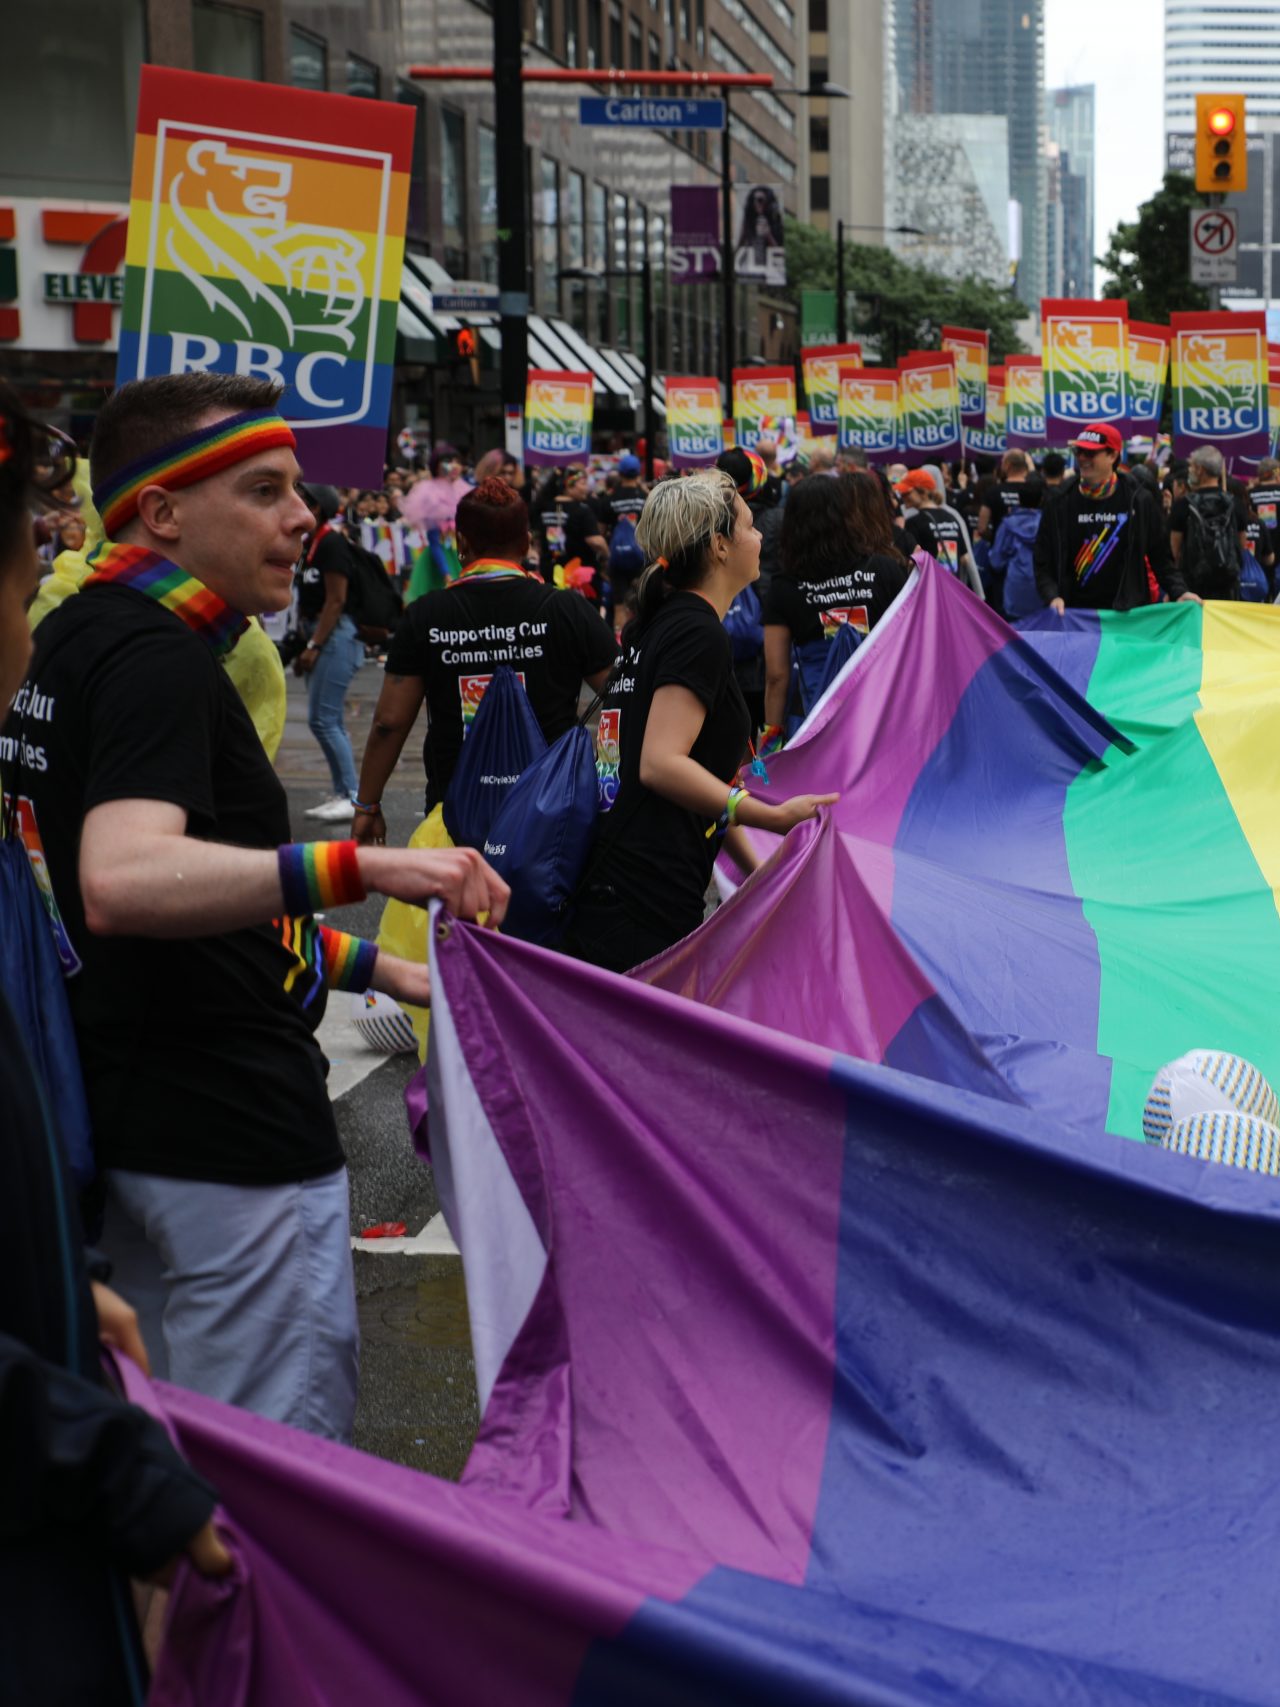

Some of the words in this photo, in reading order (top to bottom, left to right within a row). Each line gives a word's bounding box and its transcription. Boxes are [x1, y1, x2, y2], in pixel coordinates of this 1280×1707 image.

[605, 101, 682, 121] Carlton
[45, 274, 124, 300] ELEVE
[169, 331, 348, 409] RBC
[960, 392, 980, 410] BC
[1059, 391, 1118, 414] RBC
[1017, 415, 1045, 432] RB
[1190, 406, 1254, 430] RBC
[535, 432, 580, 450] RBC
[849, 429, 891, 446] RBC
[912, 422, 954, 445] RBC
[970, 431, 1007, 450] RBC
[678, 436, 715, 452] RBC
[428, 625, 516, 646] Supporting
[519, 621, 548, 637] Our
